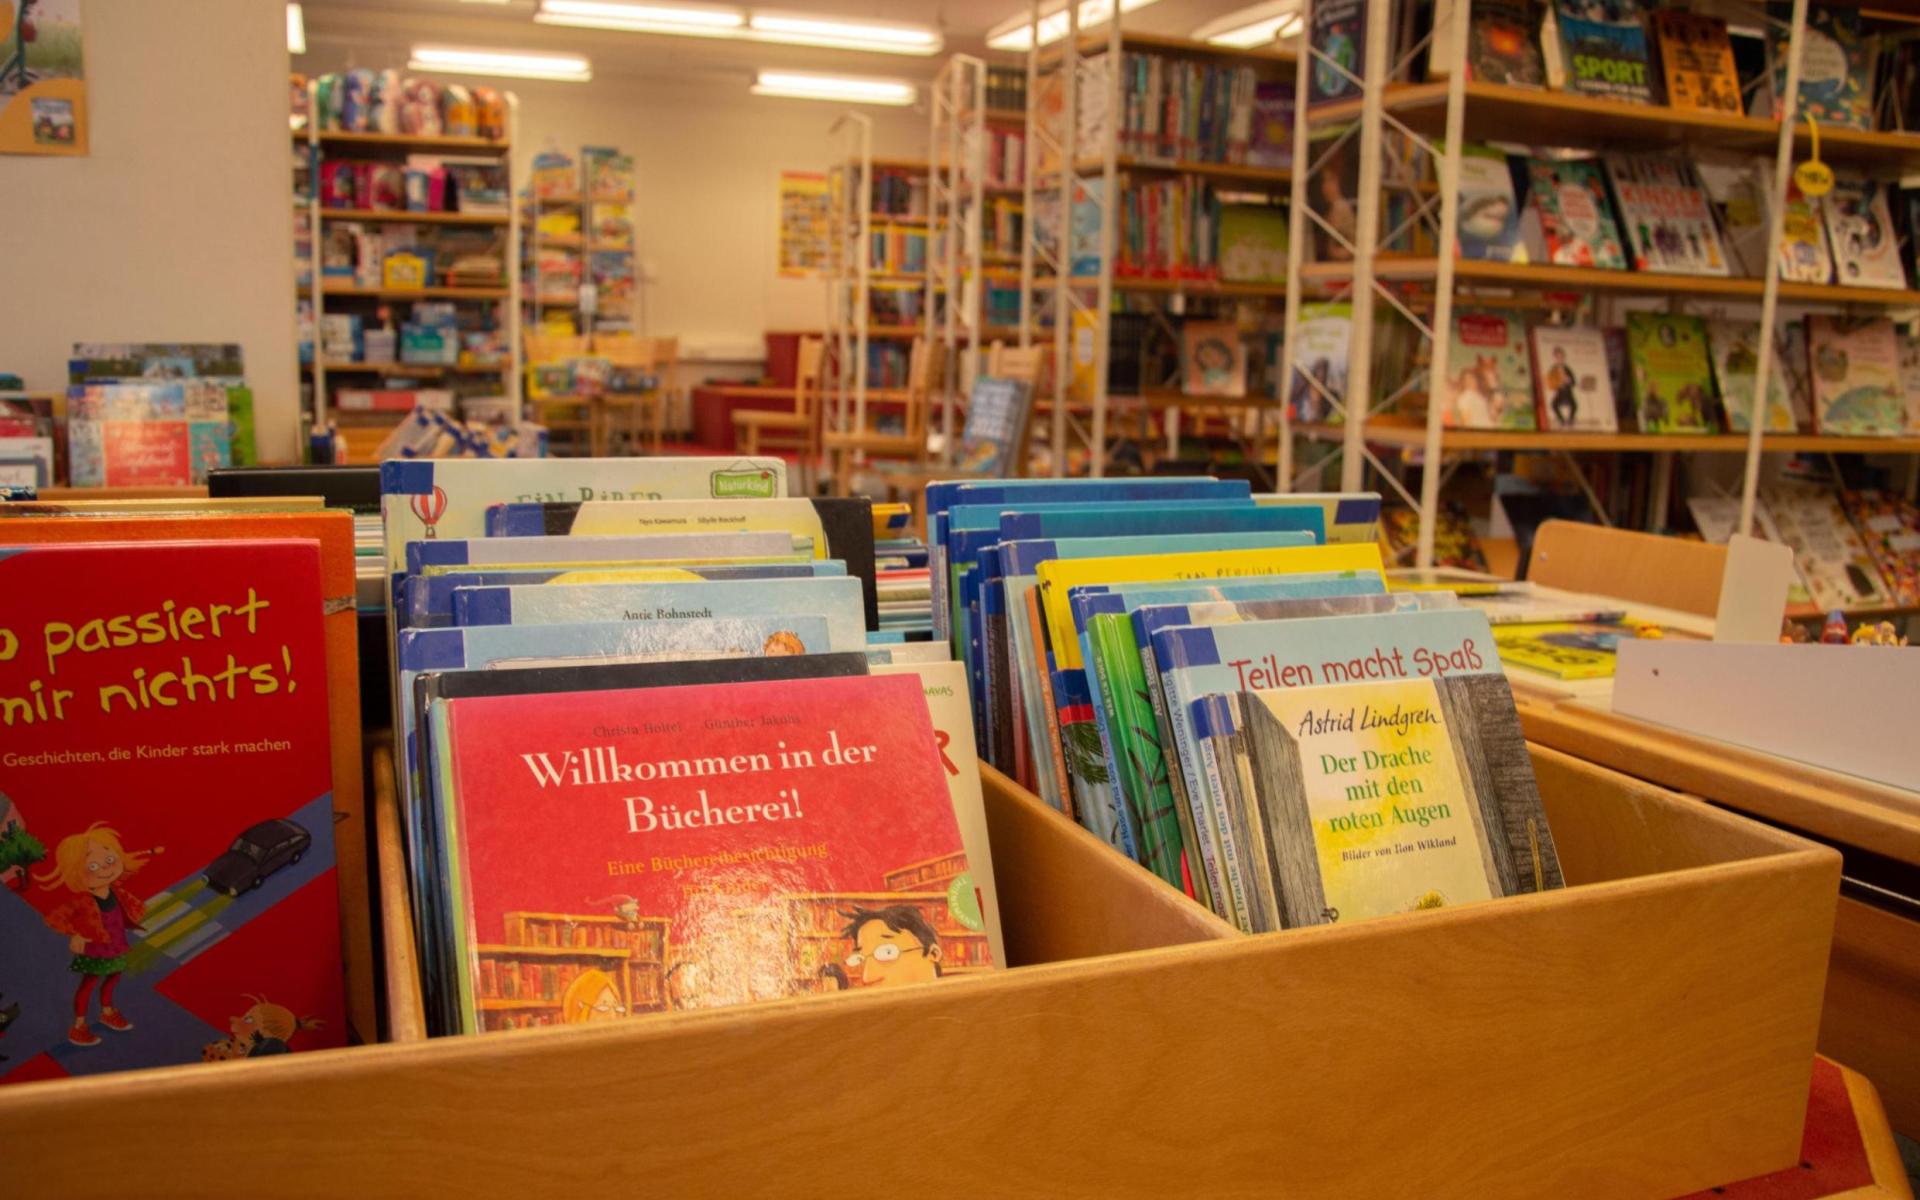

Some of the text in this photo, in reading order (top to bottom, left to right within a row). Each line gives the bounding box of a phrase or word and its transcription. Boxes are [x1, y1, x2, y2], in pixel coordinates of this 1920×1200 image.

[1573, 54, 1646, 84] SPORT
[719, 479, 769, 492] Naturkind
[656, 607, 713, 620] Bohnstedt
[0, 587, 270, 675] o passiert
[100, 645, 297, 712] nichts!
[1228, 638, 1482, 692] Teilen macht Spaß
[593, 725, 640, 738] Christa
[1298, 704, 1442, 736] Astrid Lindgren
[3, 738, 291, 768] Geschichten, die Kinder stark machen
[520, 730, 878, 788] Willkommen in der
[1320, 746, 1433, 775] Der Drache
[1172, 708, 1192, 768] Weninger
[1190, 779, 1199, 801] Eve
[1208, 856, 1218, 887] Teilen
[1345, 776, 1424, 801] mit den
[624, 788, 804, 833] Bücherei!
[1329, 803, 1452, 833] roten Augen
[1342, 850, 1371, 862] Bilder
[1375, 847, 1392, 857] von
[1417, 836, 1457, 851] Wikland
[608, 859, 646, 876] Eine
